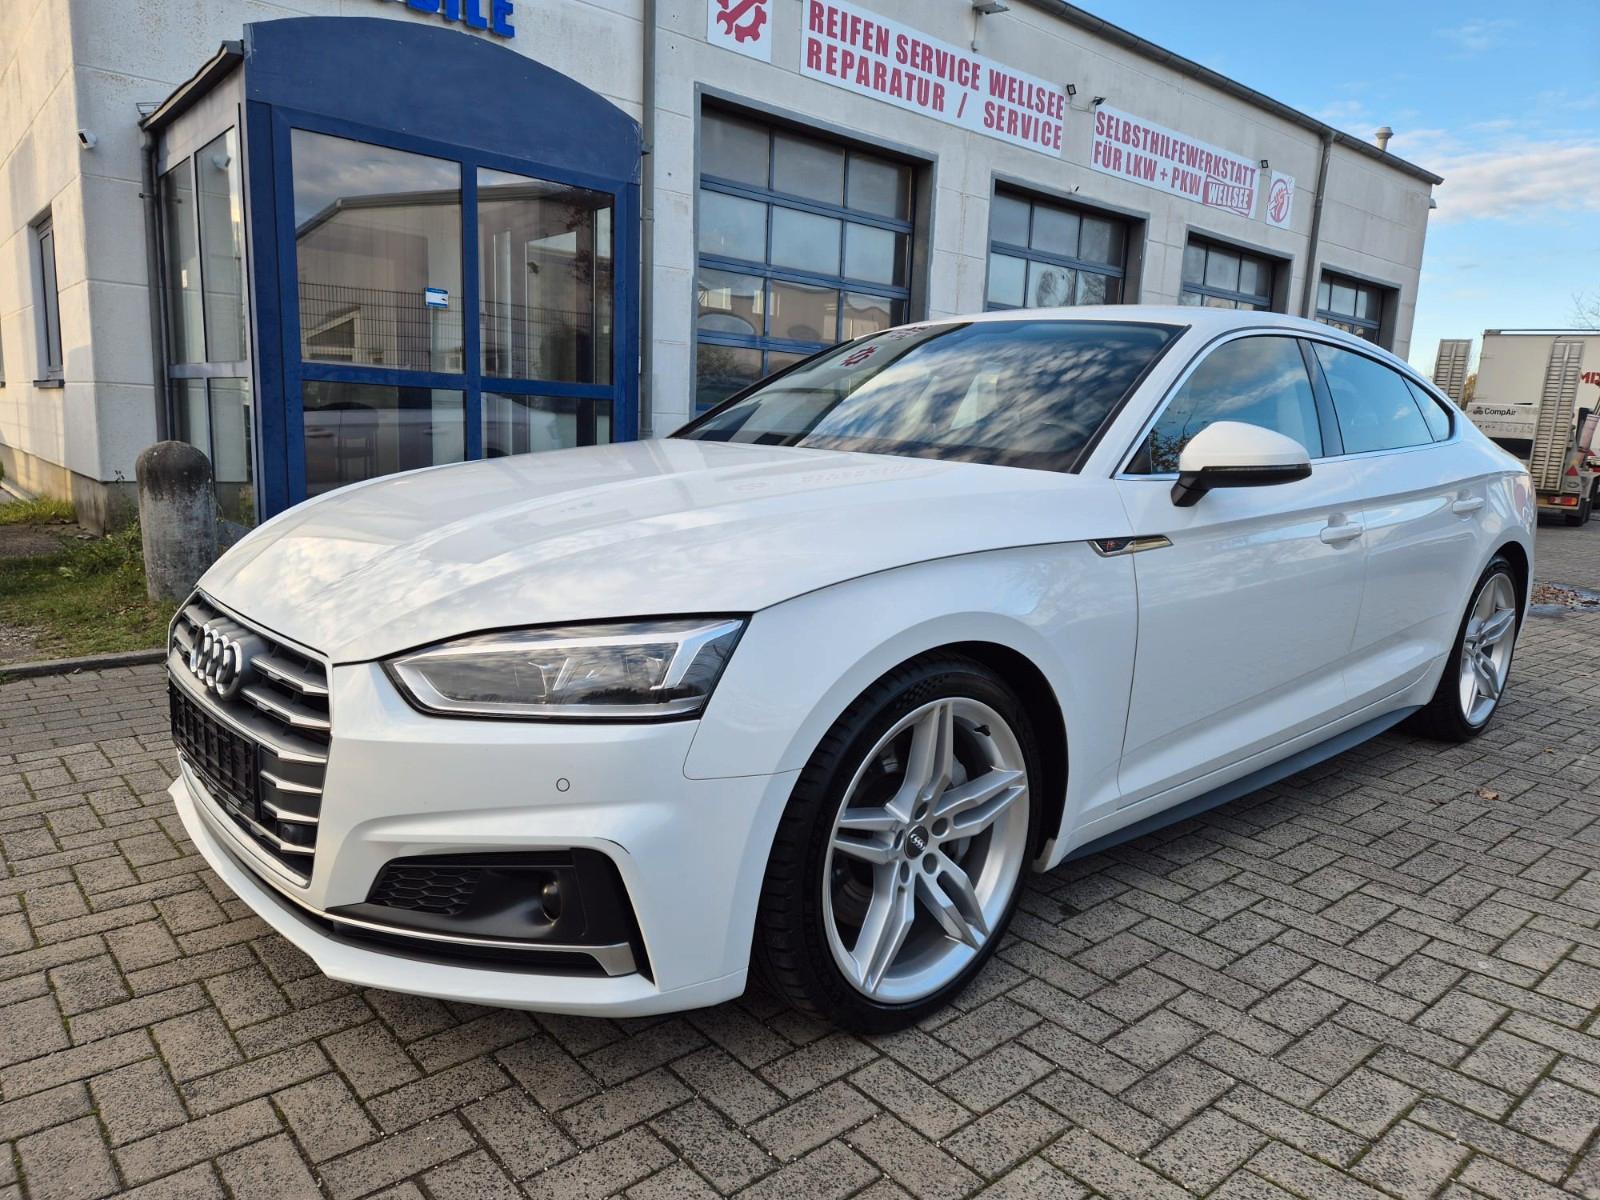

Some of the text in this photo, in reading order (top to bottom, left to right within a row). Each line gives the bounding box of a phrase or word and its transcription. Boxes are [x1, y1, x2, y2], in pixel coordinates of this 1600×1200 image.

[807, 37, 1063, 150] REPARATUR / SERVICE
[809, 0, 1065, 121] REIFEN SERVICE WELLSEE
[1093, 140, 1251, 209] FÜR LKW + PKW WELLSEE
[1095, 111, 1257, 188] SELBSTHILFEWERKSTATT
[1484, 407, 1517, 416] CompAir
